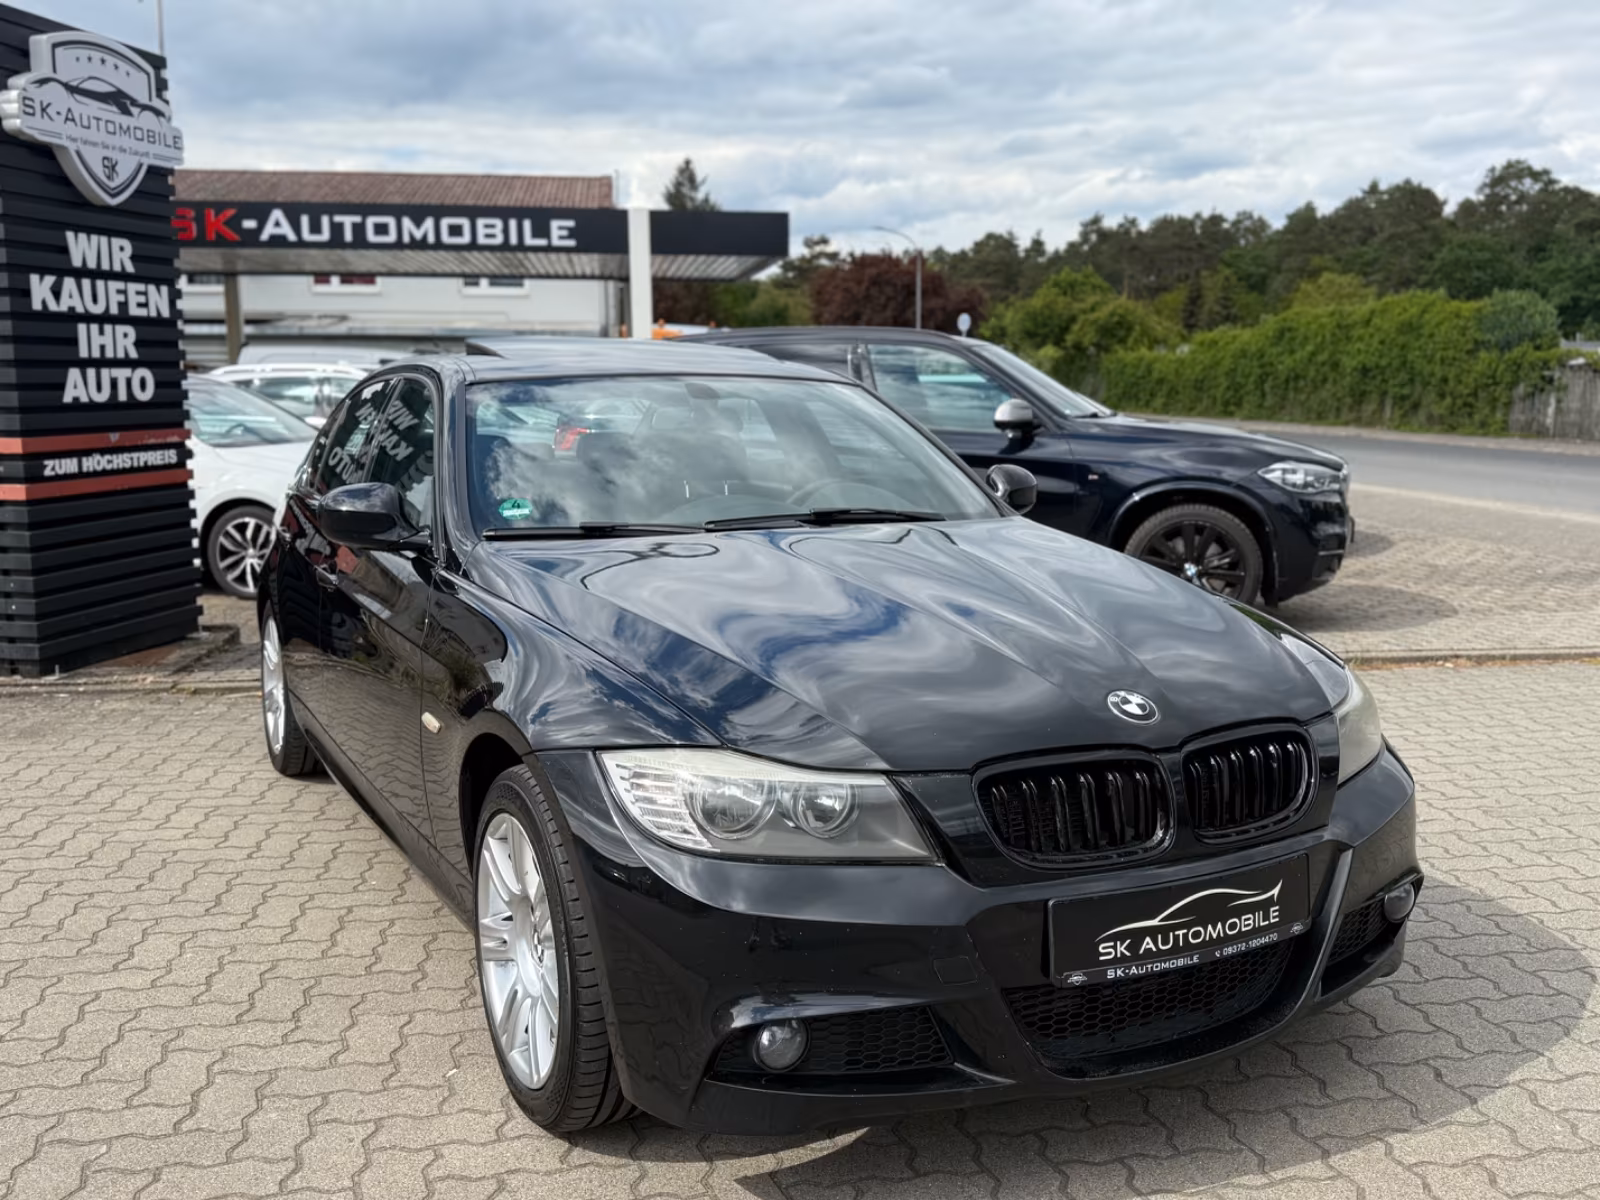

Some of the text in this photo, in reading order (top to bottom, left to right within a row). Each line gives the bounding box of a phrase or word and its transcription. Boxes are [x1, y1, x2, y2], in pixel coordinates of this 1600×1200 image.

[22, 96, 182, 150] SK-AUTOMOBILE
[102, 156, 119, 182] SK
[170, 207, 577, 248] SK-AUTOMOBILE
[65, 230, 136, 273] WIR
[29, 273, 170, 318] KAUFEN
[77, 322, 139, 359] IHR
[62, 367, 156, 404] AUTO
[43, 449, 178, 476] ZUM HÖCHSTPREIS
[1098, 906, 1280, 961] SK AUTOMOBILE
[1106, 954, 1200, 979] SK-AUTOMOBILE
